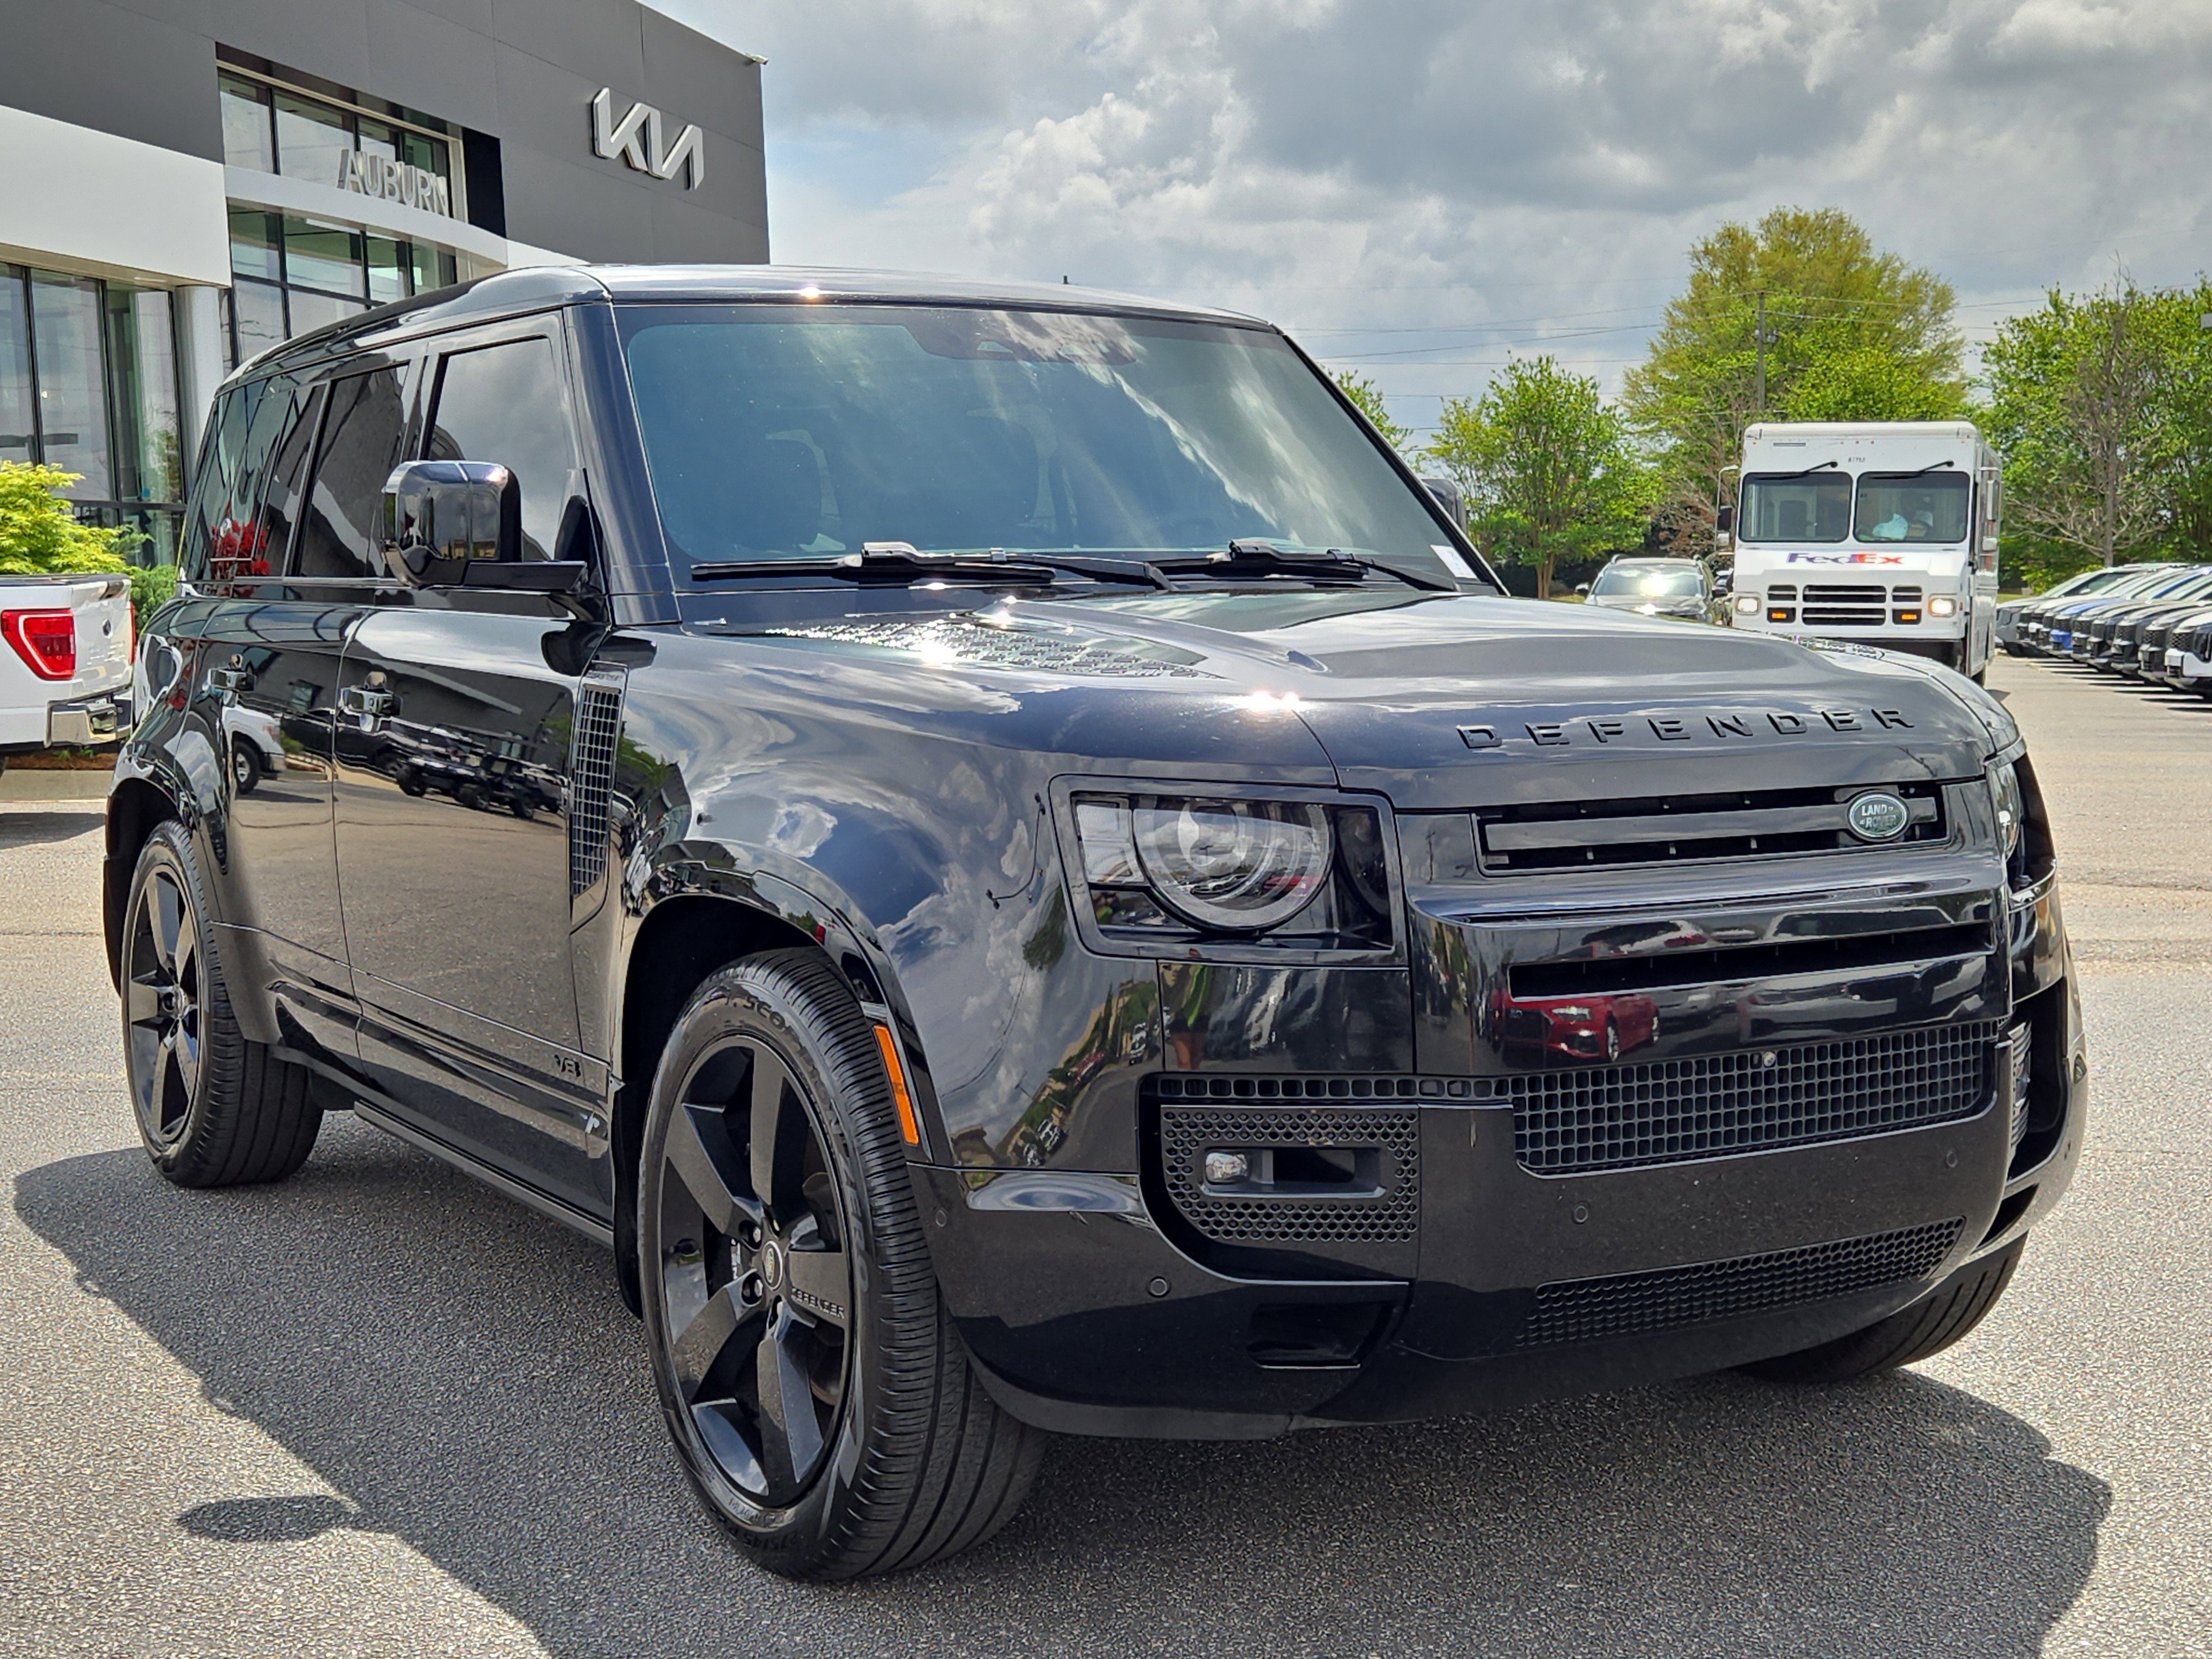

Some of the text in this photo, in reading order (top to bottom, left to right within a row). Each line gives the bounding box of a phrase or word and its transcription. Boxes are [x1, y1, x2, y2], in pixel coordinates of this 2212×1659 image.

[338, 149, 449, 216] AUBURN
[1786, 552, 1904, 564] FedEx
[1456, 708, 1915, 749] DEFENDER
[1862, 804, 1887, 816] LAND
[790, 1287, 845, 1319] DEFENDER
